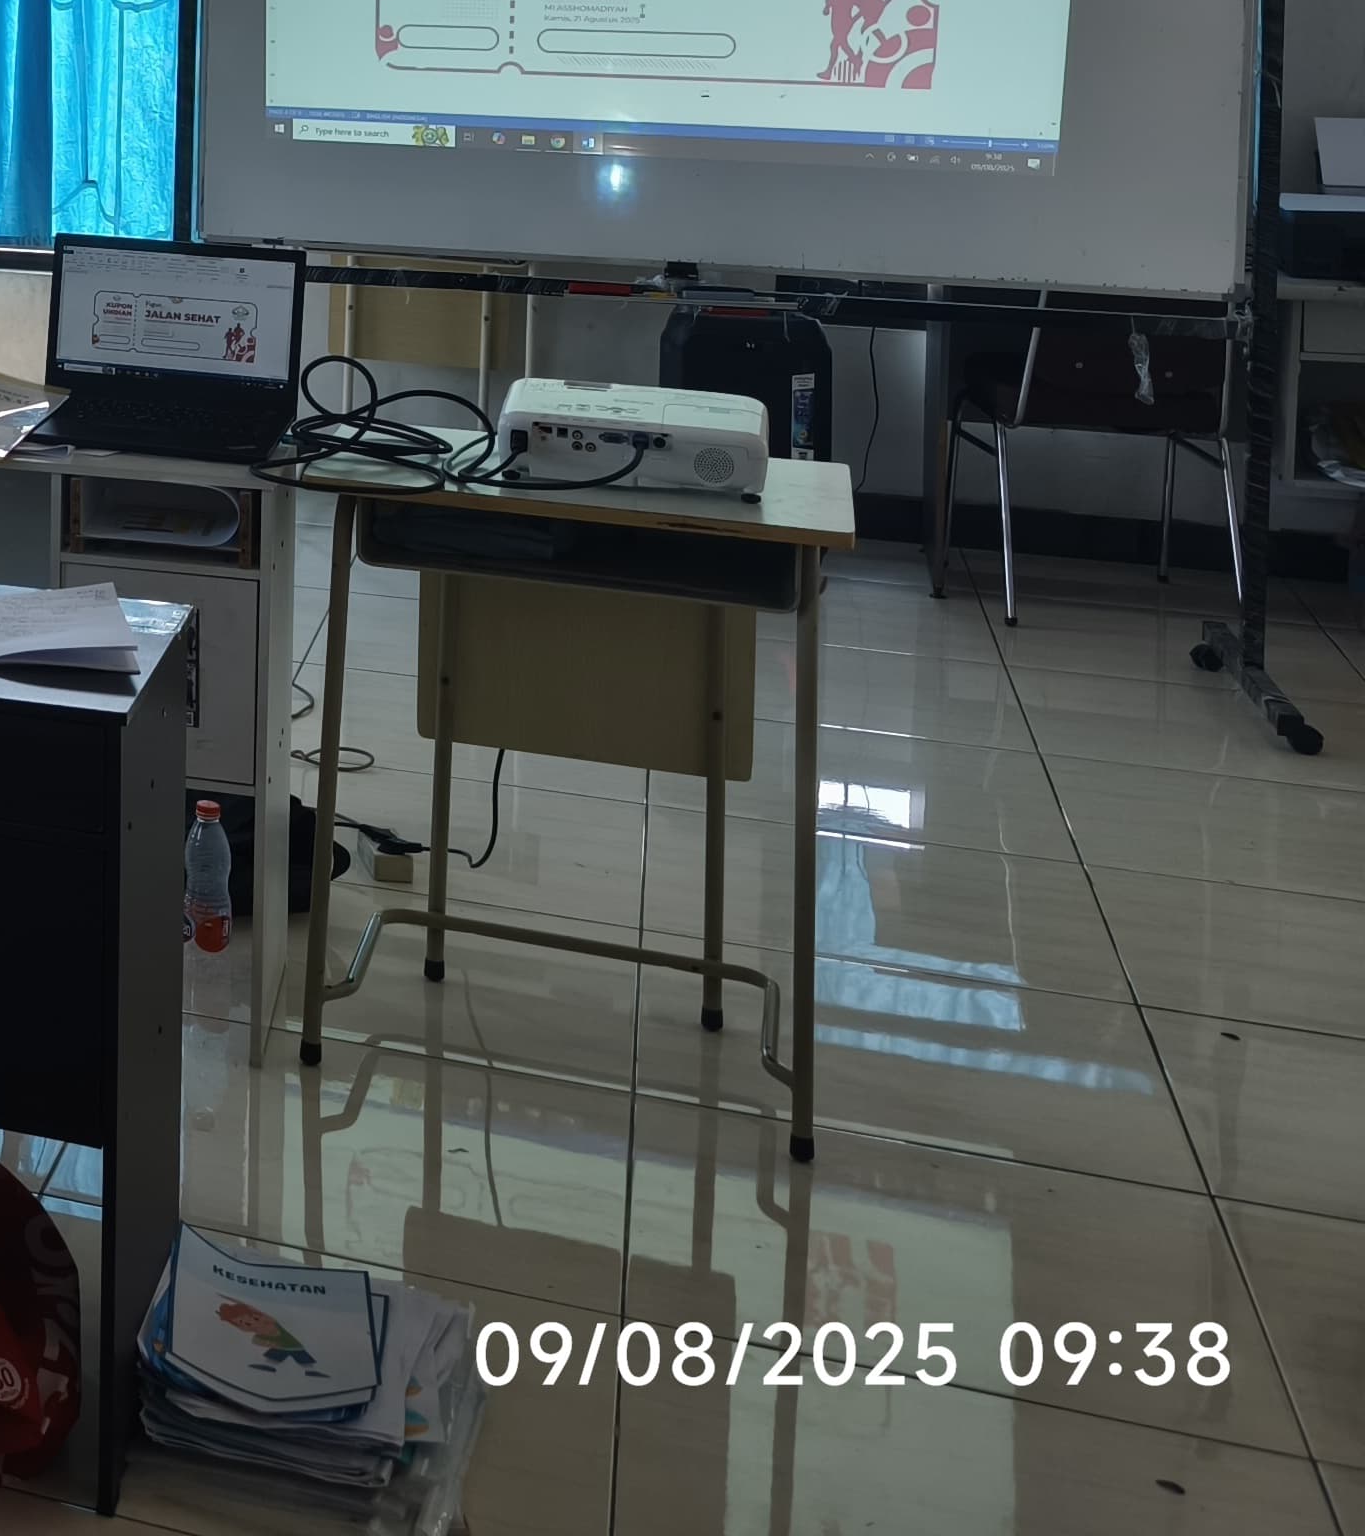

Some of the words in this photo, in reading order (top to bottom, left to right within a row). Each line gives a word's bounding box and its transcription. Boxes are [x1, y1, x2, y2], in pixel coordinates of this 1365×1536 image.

[315, 127, 333, 137] Type
[335, 128, 352, 137] here
[354, 129, 362, 137] to
[364, 129, 389, 138] search
[106, 302, 133, 310] KUPON
[102, 308, 133, 317] UNDIAN
[145, 309, 182, 321] JALAN
[184, 312, 221, 324] SEHAT
[212, 1264, 326, 1295] KESEHATAN
